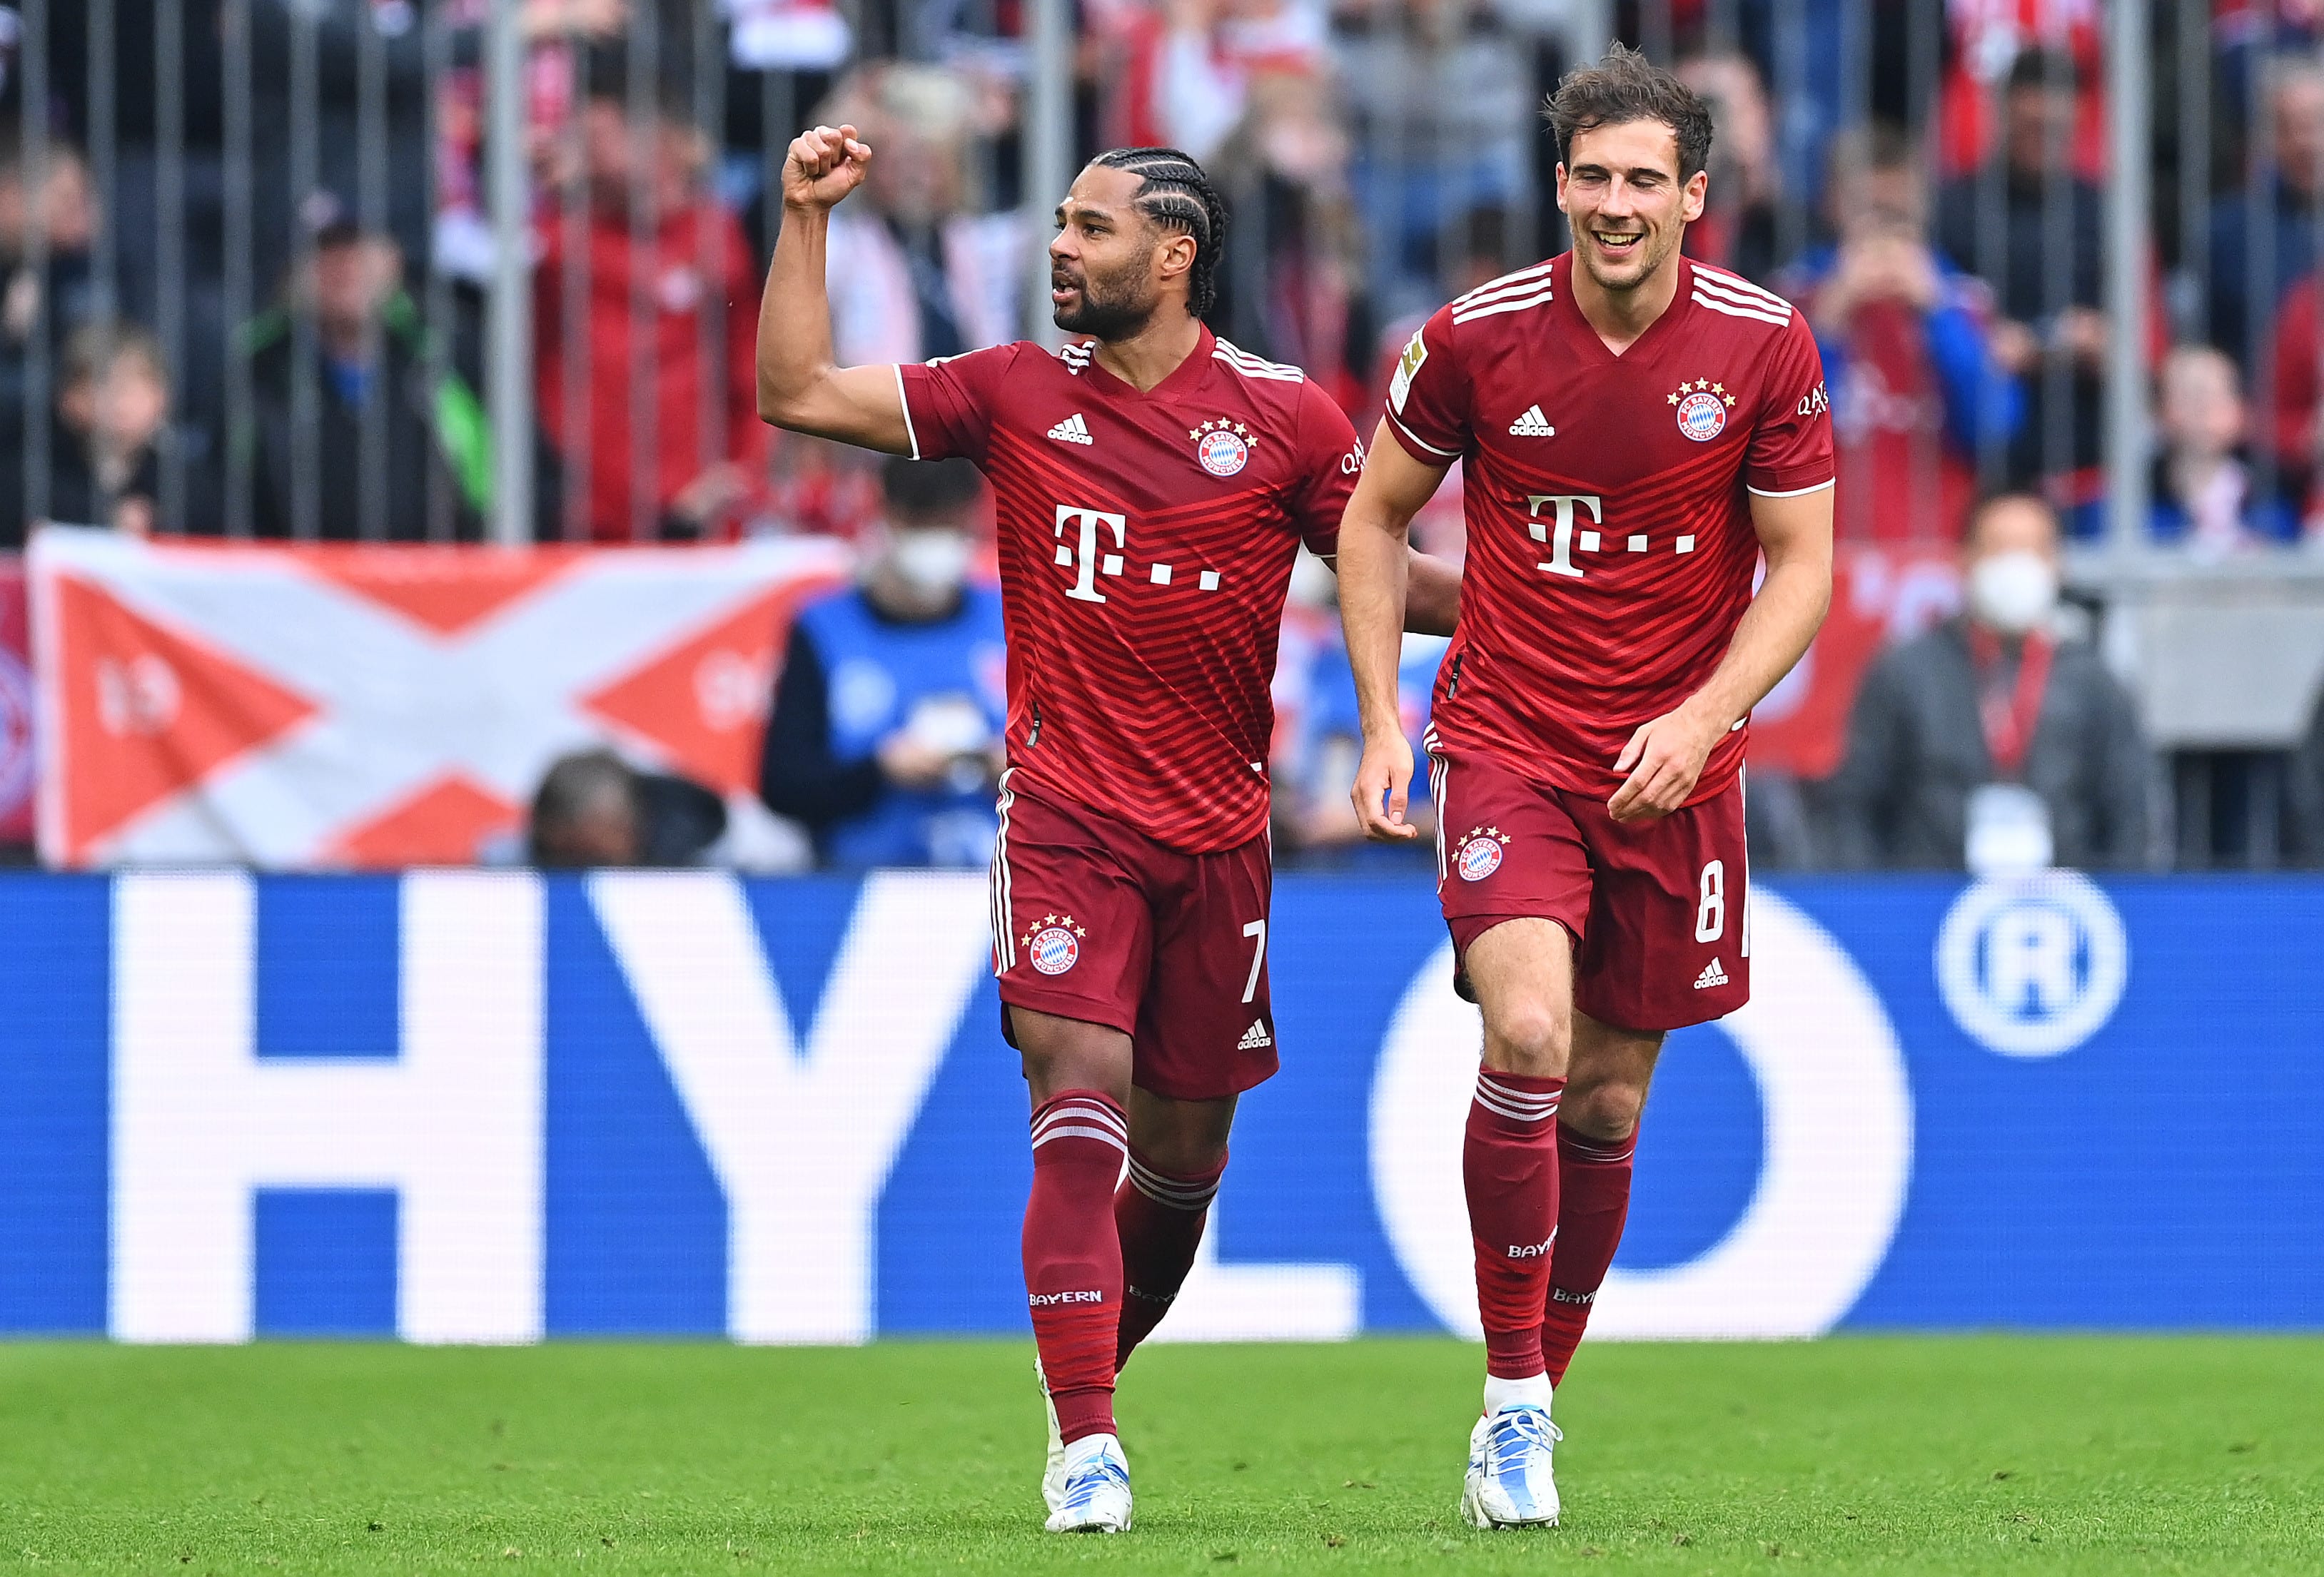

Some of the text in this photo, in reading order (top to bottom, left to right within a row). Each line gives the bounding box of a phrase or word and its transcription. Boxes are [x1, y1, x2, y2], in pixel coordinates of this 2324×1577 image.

[1681, 396, 1722, 415] FC BAYERN
[1047, 428, 1093, 445] adidas
[1509, 425, 1555, 437] adidas
[1214, 433, 1244, 452] BAYERN
[1467, 841, 1497, 853] BAYERN
[1695, 860, 1724, 943] 8
[1042, 931, 1073, 947] BAYERN
[1241, 918, 1265, 1003] 7
[1693, 975, 1729, 990] adidas
[1237, 1037, 1271, 1050] adidas
[107, 869, 1914, 1344] HYO
[1029, 1289, 1102, 1306] BAYERN
